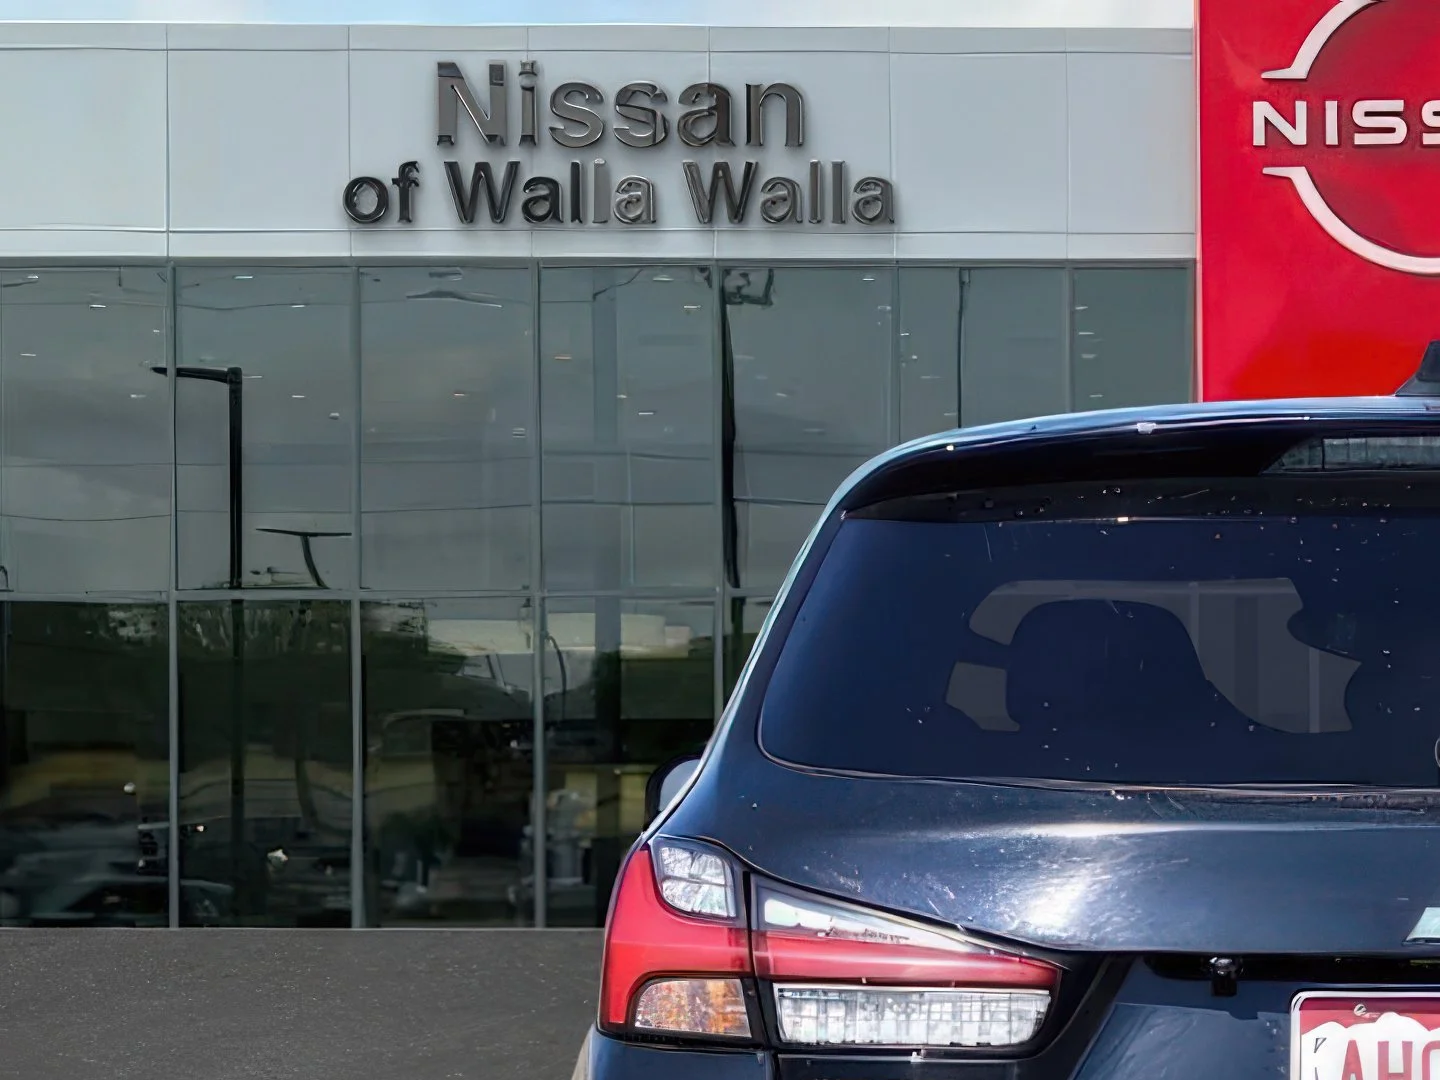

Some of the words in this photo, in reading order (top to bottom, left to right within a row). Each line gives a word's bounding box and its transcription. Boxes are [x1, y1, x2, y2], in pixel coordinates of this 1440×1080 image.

[436, 60, 806, 147] Nissan
[343, 160, 420, 223] of
[444, 159, 656, 224] Walla
[682, 160, 895, 224] Walla
